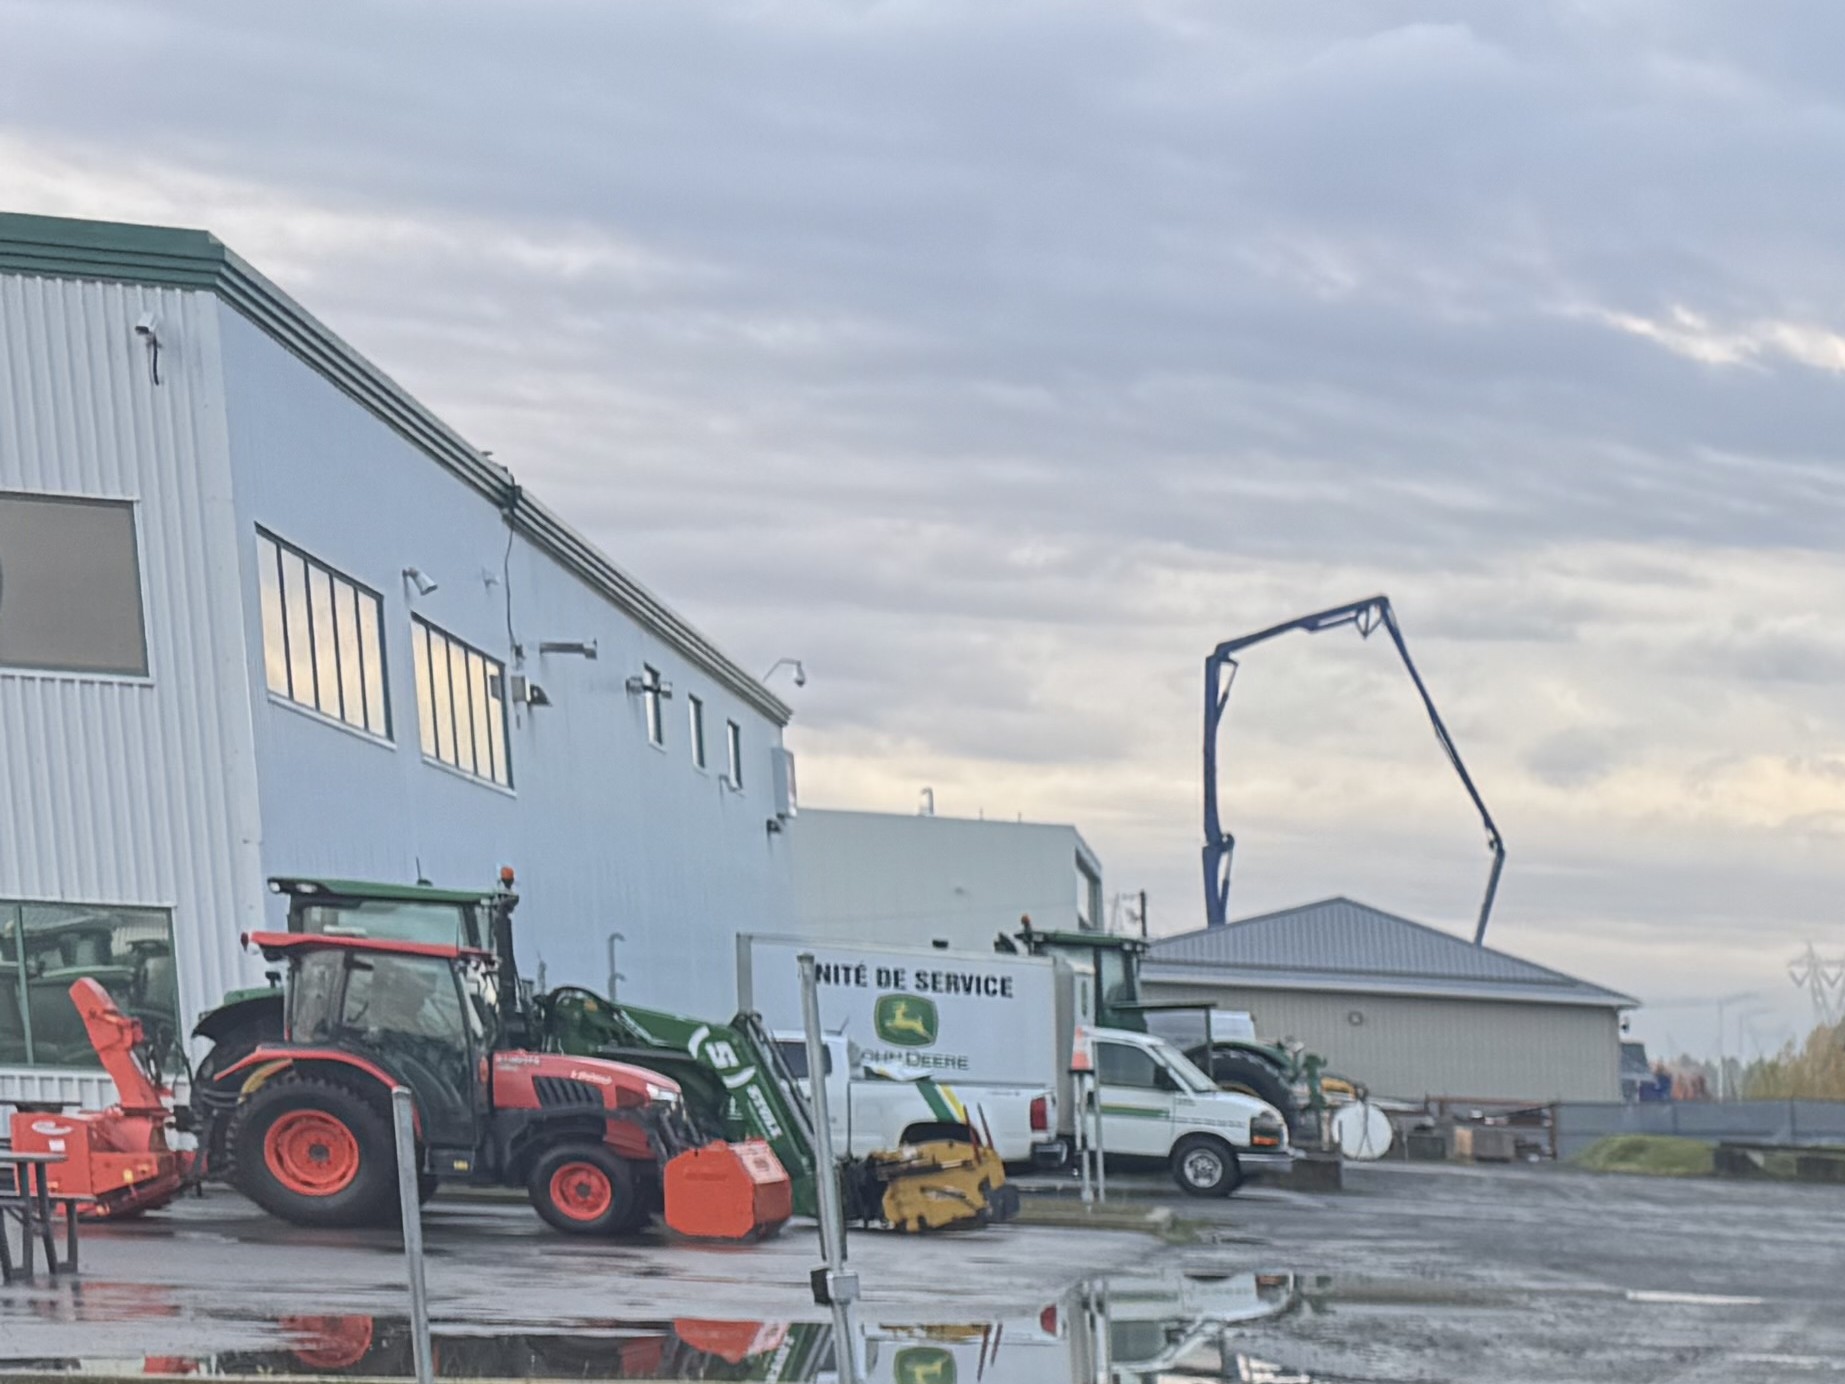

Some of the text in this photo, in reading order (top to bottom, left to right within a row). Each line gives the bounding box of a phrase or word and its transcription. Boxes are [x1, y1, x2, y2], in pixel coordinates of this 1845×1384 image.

[815, 961, 1014, 999] NITÉ DE SERVICE
[905, 1051, 970, 1071] DEERE
